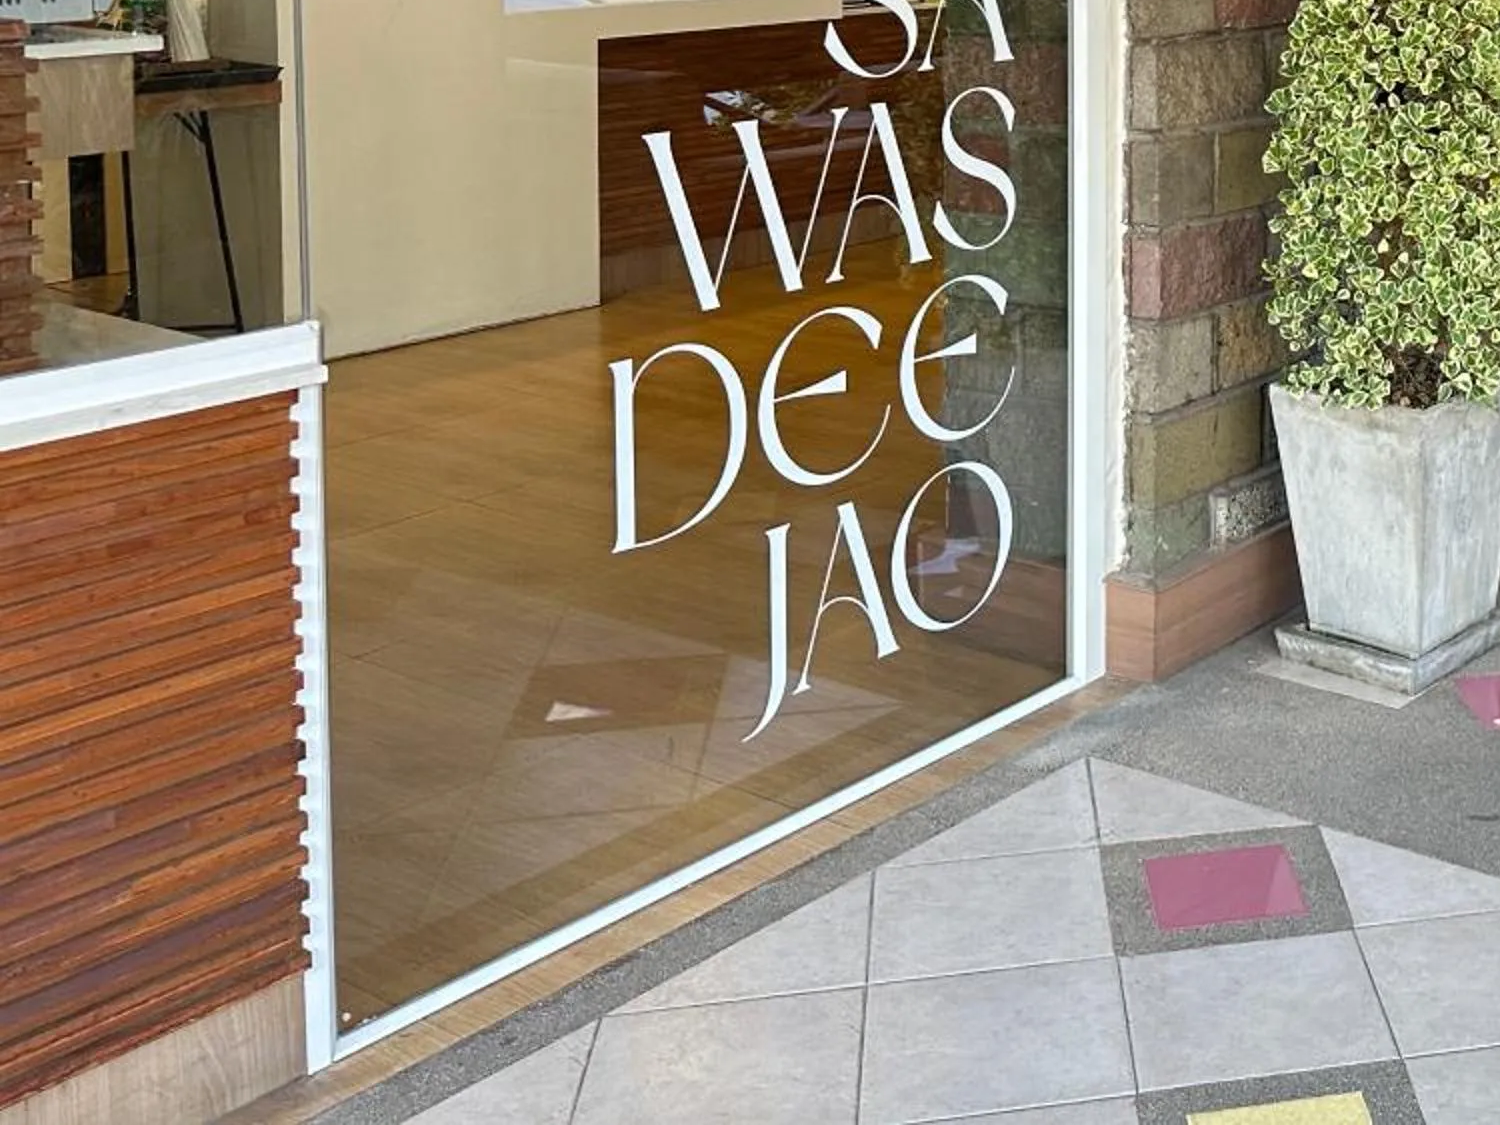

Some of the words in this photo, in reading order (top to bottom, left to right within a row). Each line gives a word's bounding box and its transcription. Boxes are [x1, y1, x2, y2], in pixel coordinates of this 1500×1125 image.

[642, 86, 1017, 312] WAS
[609, 275, 1015, 553] DEE
[740, 461, 1014, 743] JAO
